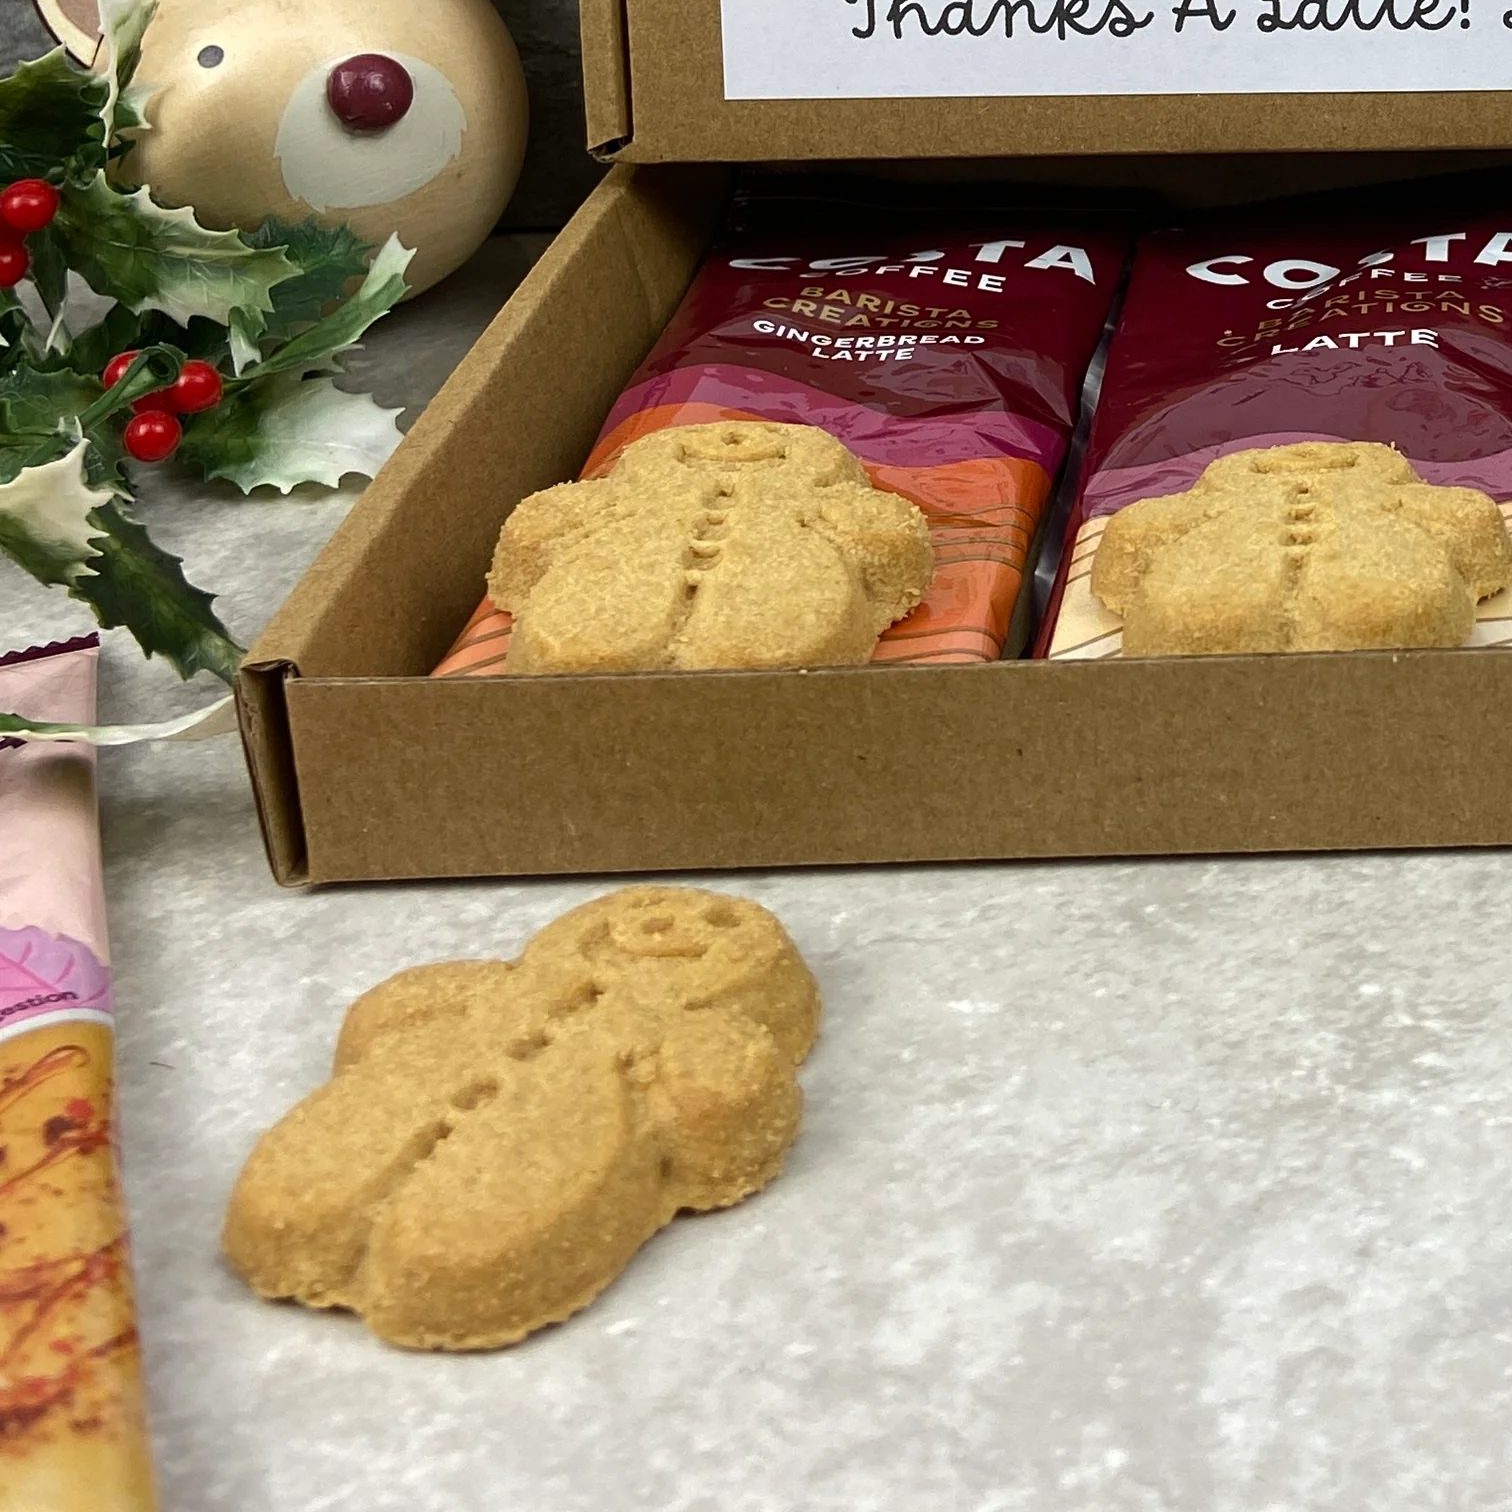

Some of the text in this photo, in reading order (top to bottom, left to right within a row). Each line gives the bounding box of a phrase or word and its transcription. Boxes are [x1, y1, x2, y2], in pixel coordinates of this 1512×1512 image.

[761, 297, 1000, 330] CREATIONS
[800, 285, 973, 320] BARISTA
[752, 319, 987, 350] GINGERBREAD
[1215, 300, 1506, 347] CREATIONS
[810, 346, 917, 363] LATTE
[1270, 328, 1440, 356] LATTE
